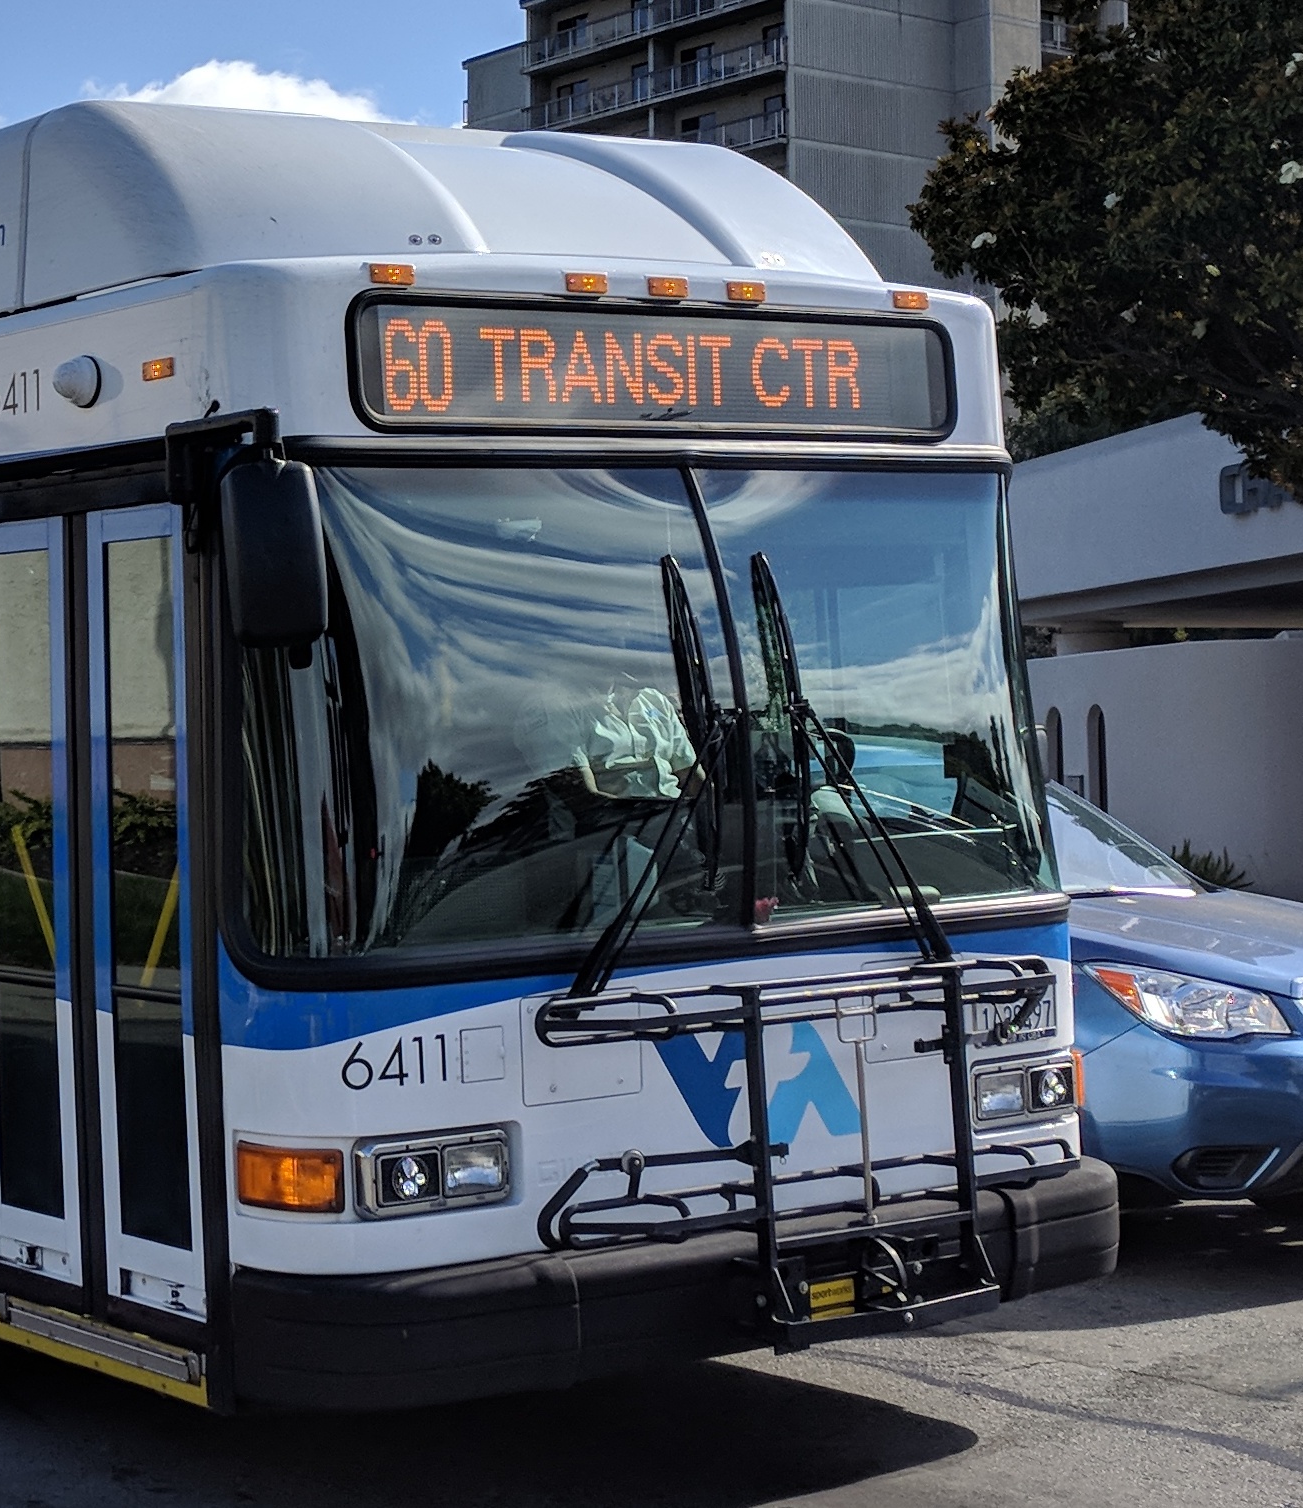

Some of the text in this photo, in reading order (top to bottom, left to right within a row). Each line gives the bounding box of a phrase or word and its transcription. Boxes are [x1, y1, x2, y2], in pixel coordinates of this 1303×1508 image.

[384, 317, 862, 412] 60 TRANSIT CTR
[341, 1033, 448, 1090] 6411
